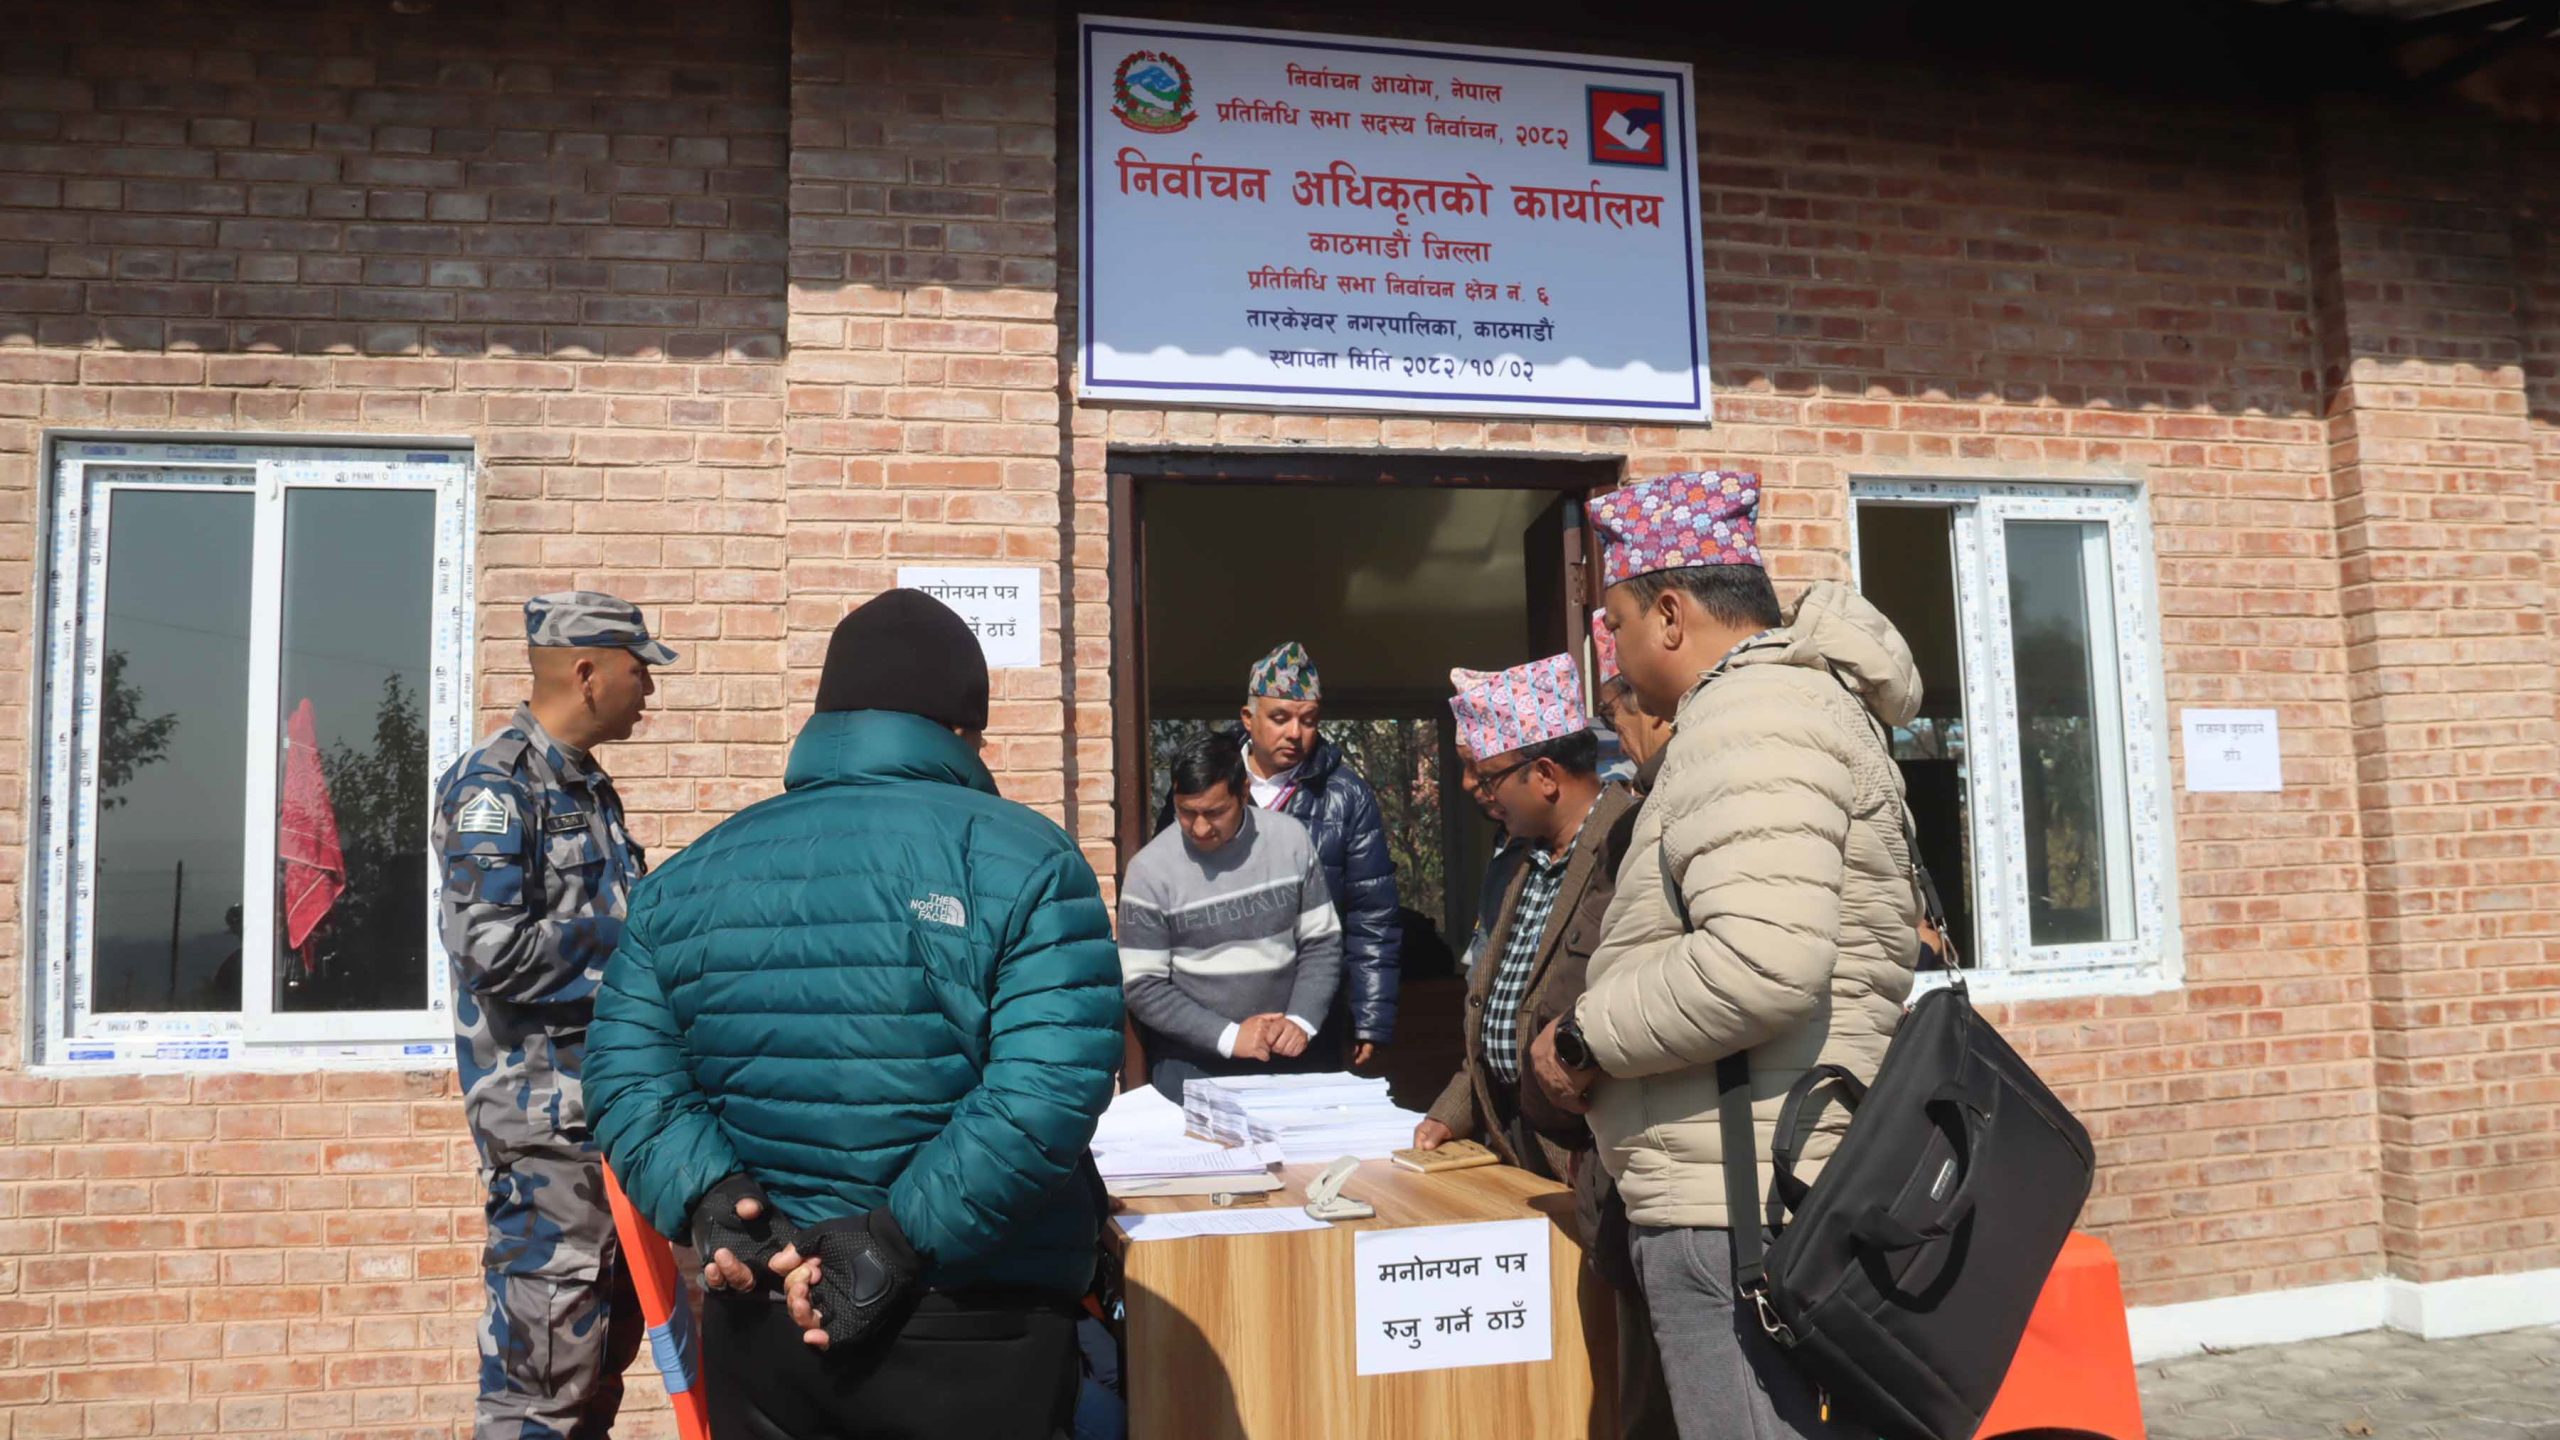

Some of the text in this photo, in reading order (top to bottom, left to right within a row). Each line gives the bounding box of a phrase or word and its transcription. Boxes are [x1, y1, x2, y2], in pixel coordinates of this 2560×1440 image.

[1286, 62, 1502, 103] निर्वाचन आयोग, नेपाल
[1216, 97, 1569, 150] प्रतिनिधि सभा सदस्य निर्वाचन, २०८२
[1114, 147, 1665, 229] निर्वाचन अधिकृतको कार्यालय
[1307, 228, 1492, 264] काठमाडौं जिल्ला
[1247, 265, 1328, 291] प्रतिनिधि
[1337, 275, 1376, 294] सभा
[1385, 272, 1455, 298] निर्वाचन
[1465, 278, 1498, 302] क्षेत्र
[1537, 286, 1550, 306] ६
[1246, 306, 1555, 342] तारकेश्वर नगरपालिका, काठमाडौं
[1269, 346, 1534, 382] स्थापना मिति २०८२/१०/०२
[993, 584, 1019, 600] पत्र
[985, 616, 1017, 638] ठाउँ
[910, 898, 948, 916] NORTH
[917, 910, 950, 922] FACE
[928, 892, 950, 905] THE
[1378, 1253, 1528, 1283] मनोनयन पत्र
[1382, 1300, 1527, 1349] रुजु गर्ने ठाउँ
